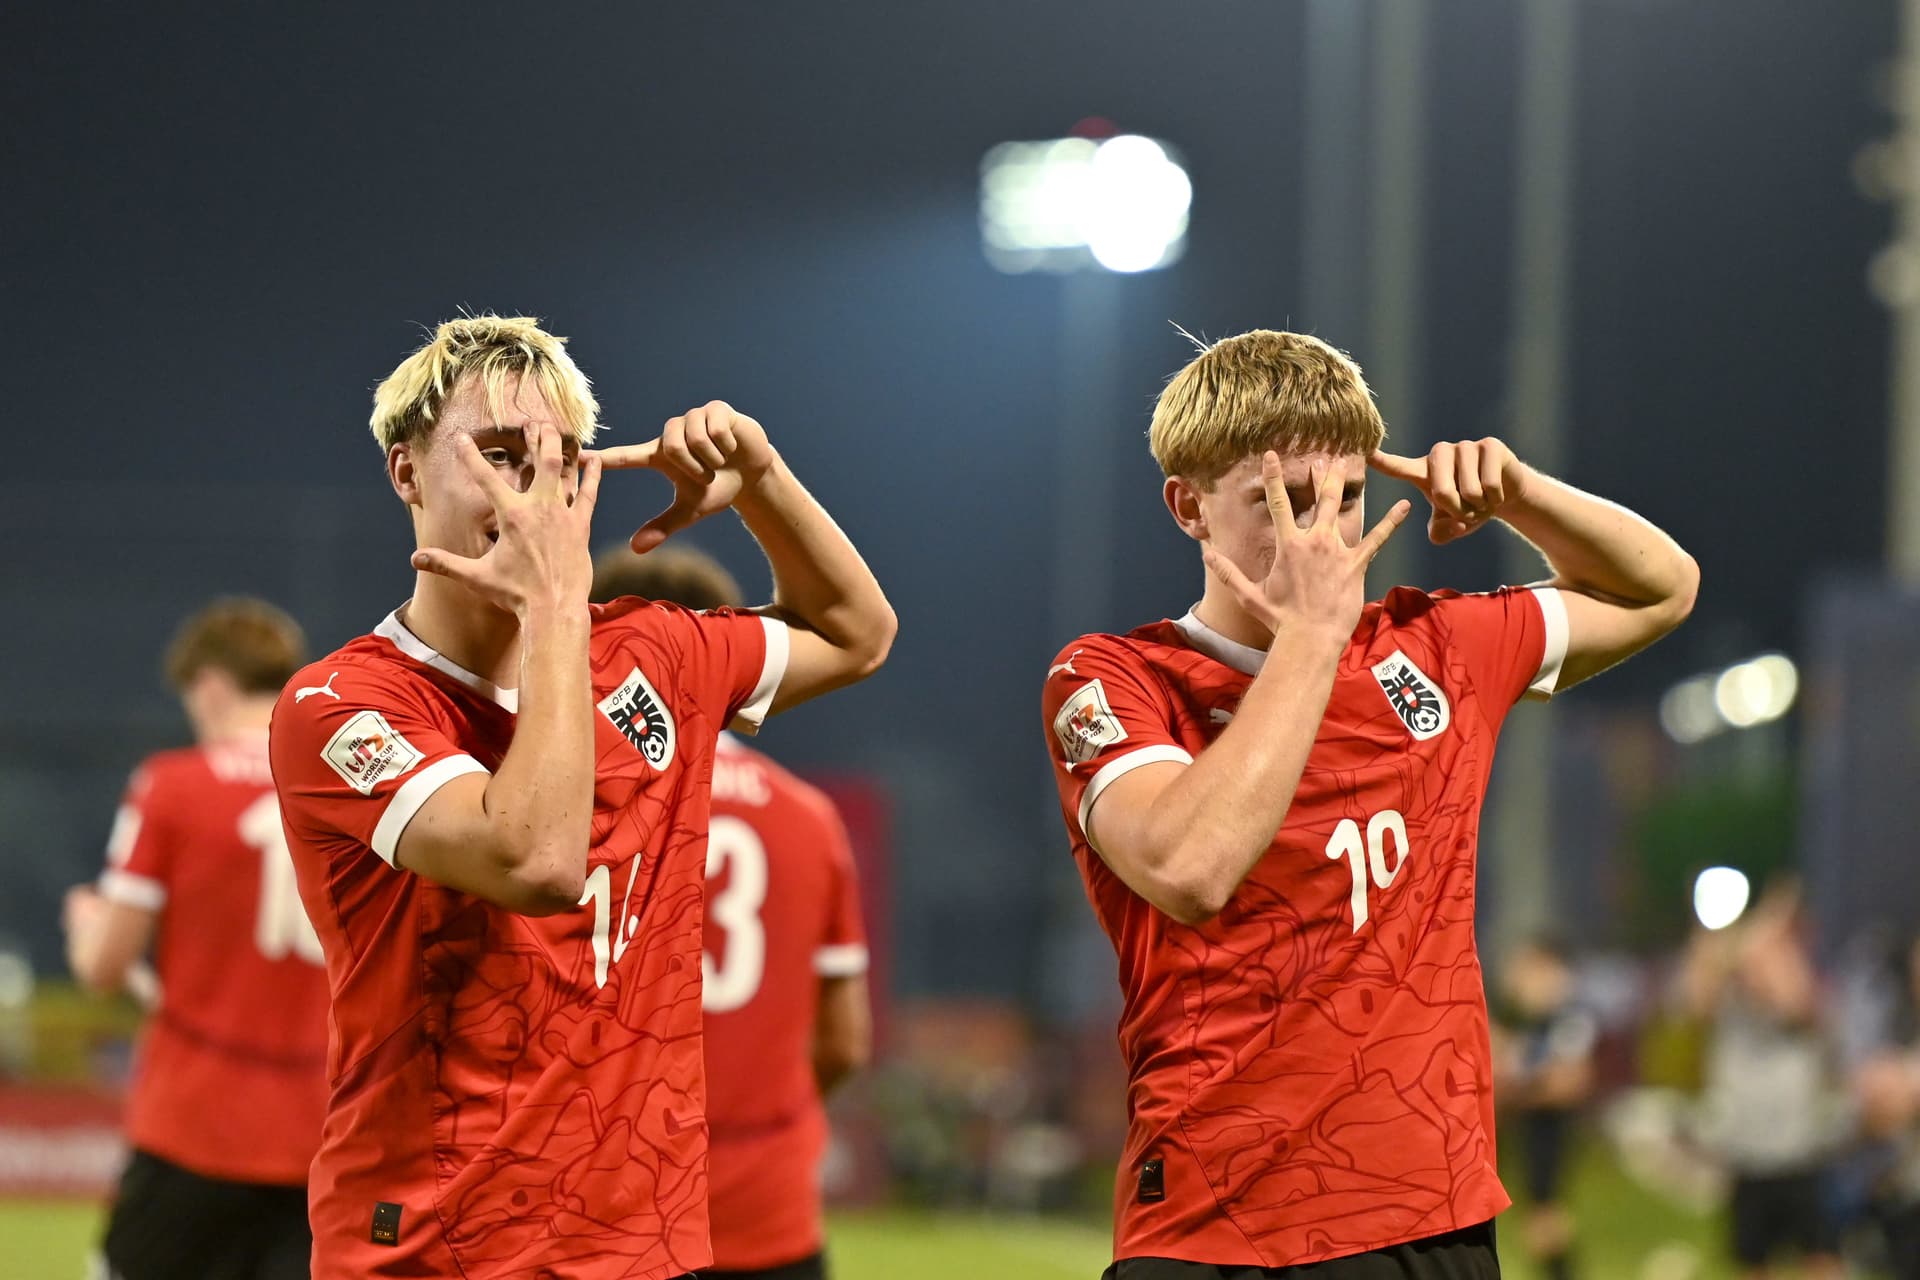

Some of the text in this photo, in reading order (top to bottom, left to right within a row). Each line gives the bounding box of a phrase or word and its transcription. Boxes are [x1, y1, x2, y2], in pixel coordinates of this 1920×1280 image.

[347, 736, 362, 752] FIFA
[361, 744, 394, 783] WORLD CUP
[1325, 809, 1410, 936] 10
